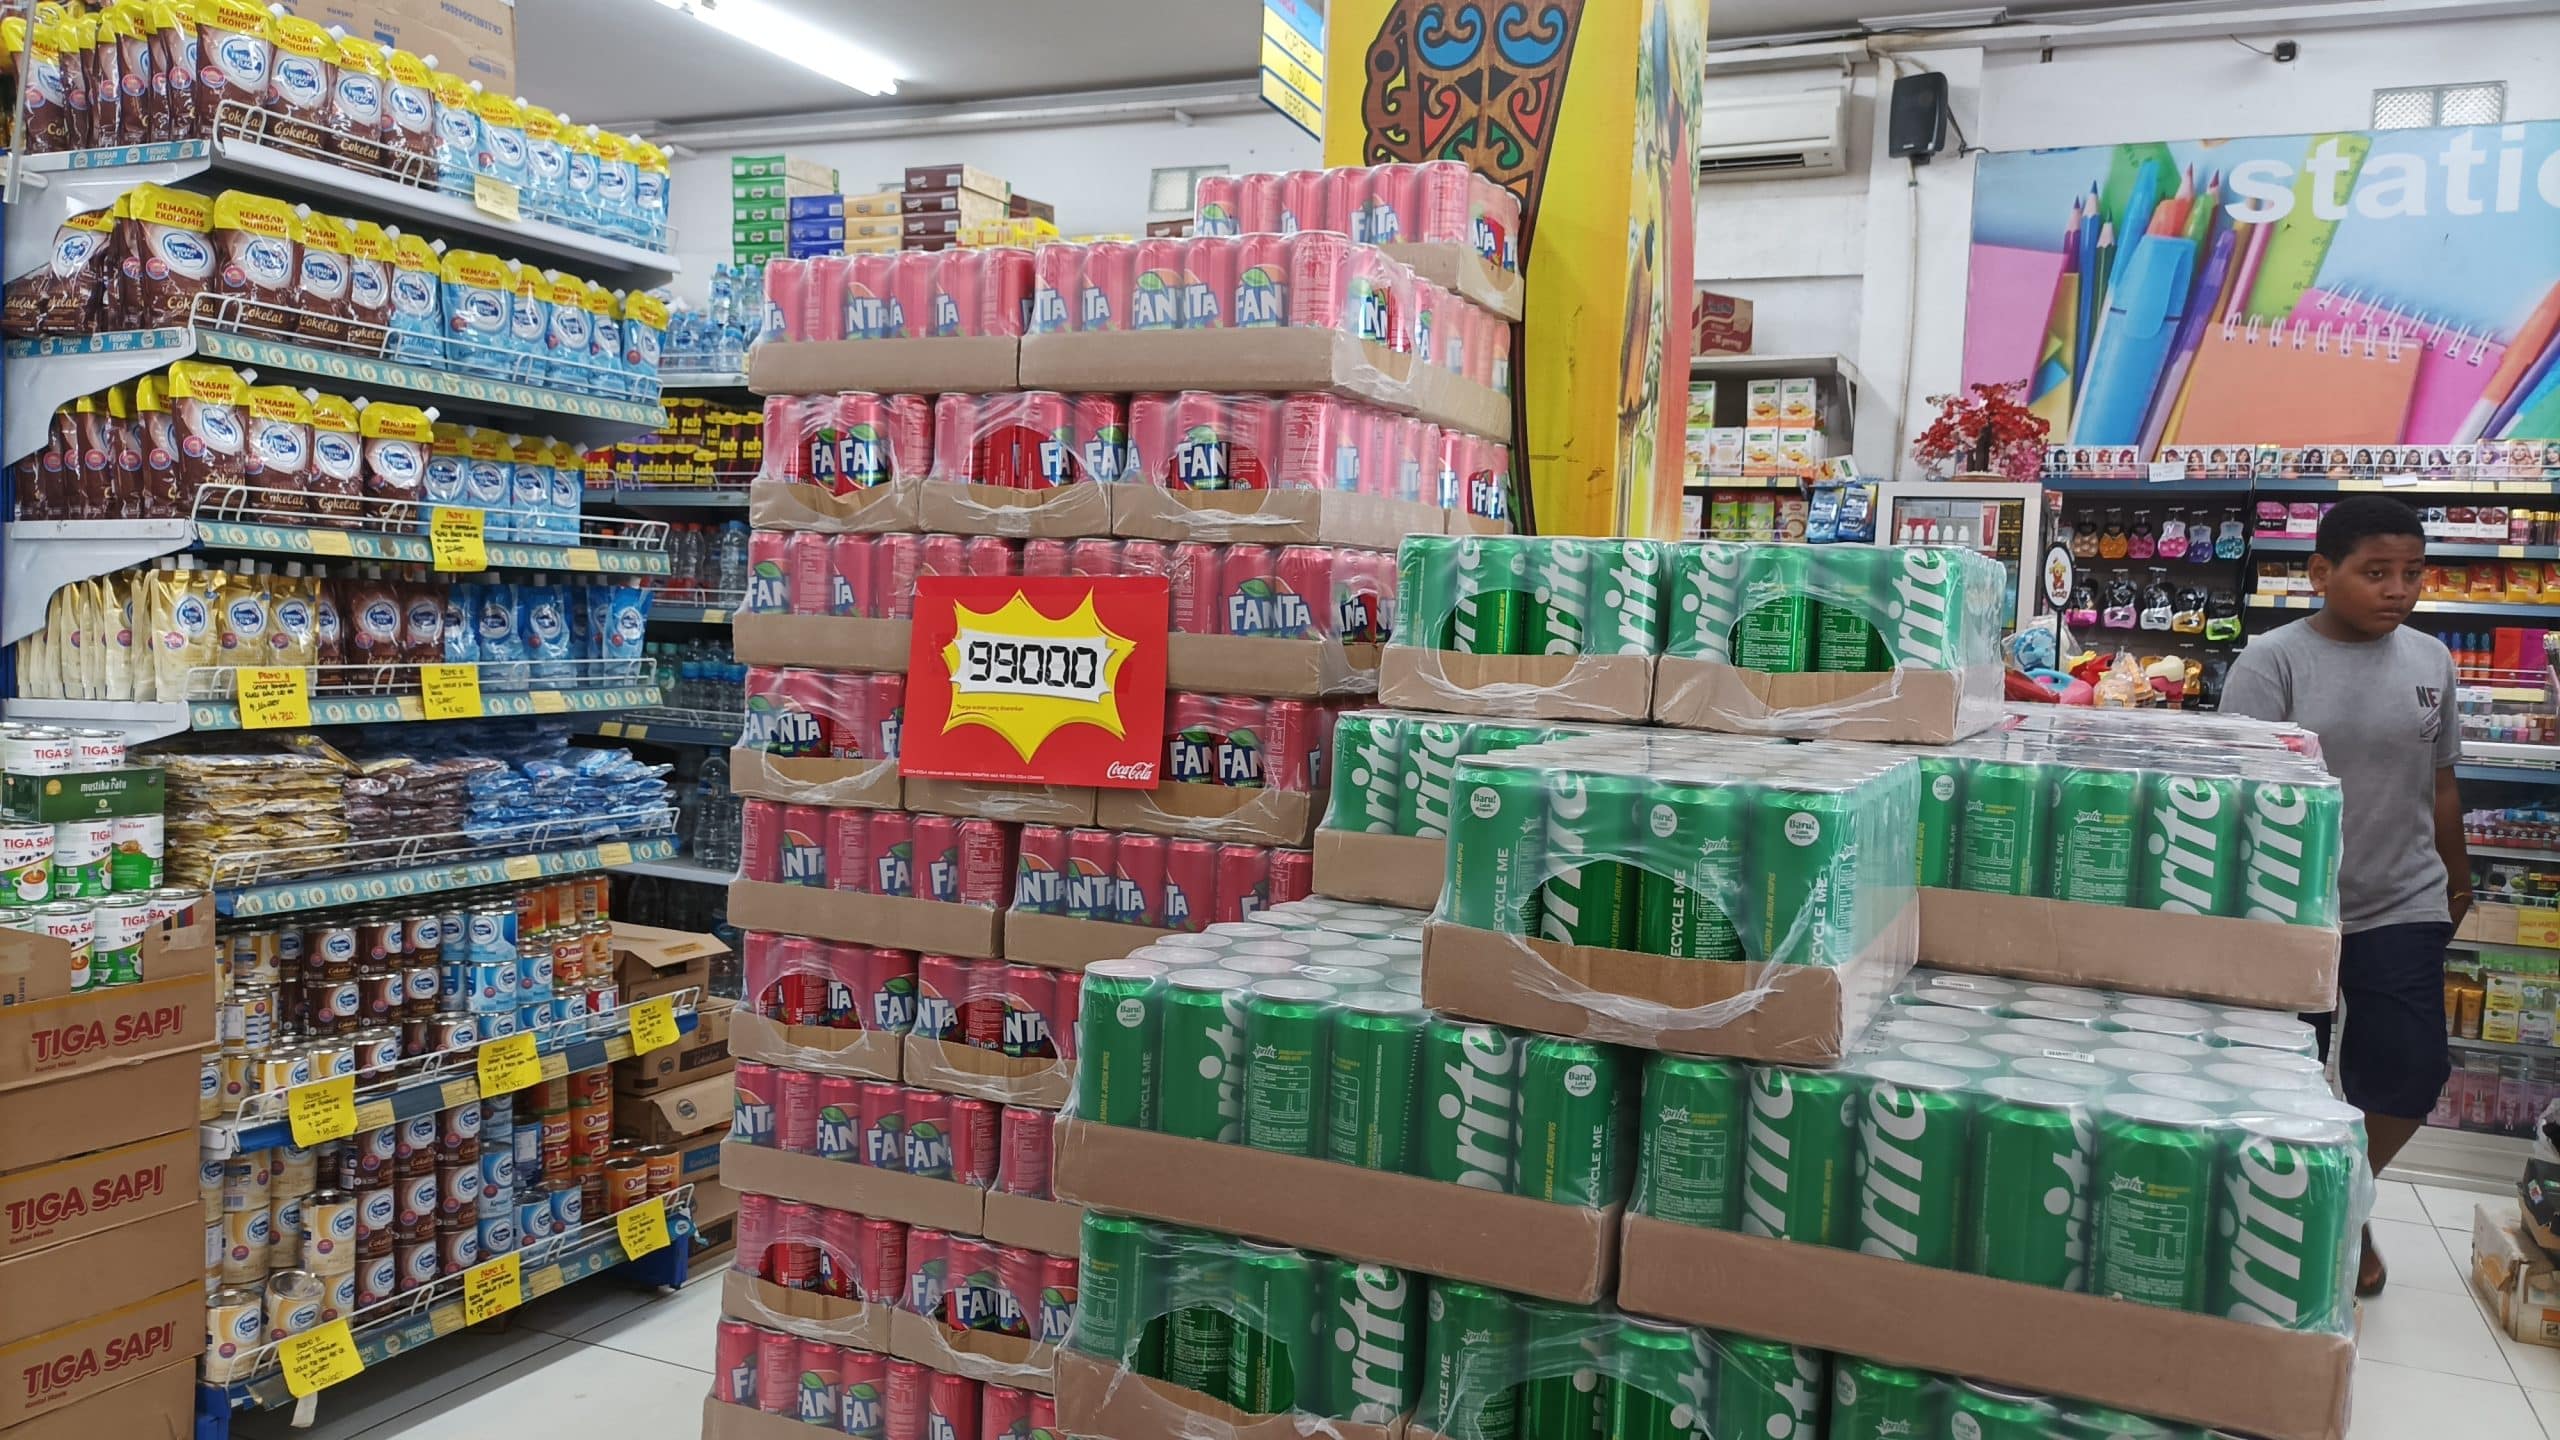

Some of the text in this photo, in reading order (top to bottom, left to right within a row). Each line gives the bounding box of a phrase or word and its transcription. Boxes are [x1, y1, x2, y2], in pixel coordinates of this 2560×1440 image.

[218, 7, 262, 24] KEMASAN
[156, 200, 204, 217] KEMASAN
[239, 210, 284, 224] KEMASAN
[155, 211, 205, 228] EKONOMIS
[255, 397, 295, 410] KEMASAN
[378, 427, 416, 438] EKONOMIS
[380, 419, 417, 431] KEMASAN
[1178, 441, 1227, 478] FAN
[318, 496, 361, 512] Cokelat
[833, 576, 854, 606] TA
[968, 641, 1097, 689] 99000
[780, 713, 821, 744] NTA
[34, 749, 62, 759] TIGA
[81, 746, 110, 756] TIGA
[1474, 793, 1497, 805] Baru!
[1788, 819, 1815, 831] Baru!
[3, 839, 34, 850] TIGA
[2057, 833, 2064, 853] ME
[1497, 847, 1509, 870] ME
[1674, 869, 1686, 893] ME
[1167, 885, 1188, 916] TA
[121, 916, 146, 928] TIGA
[48, 925, 79, 937] TIGA
[918, 997, 959, 1030] NTA
[1120, 1004, 1142, 1014] Baru!
[32, 1004, 183, 1063] TIGA SAPI
[1143, 1052, 1152, 1071] ME
[1568, 1071, 1593, 1083] Baru!
[1593, 1124, 1602, 1149] ME
[6, 1165, 163, 1233] TIGA SAPI
[23, 1321, 173, 1399] TIGA SAPI
[1441, 1354, 1451, 1383] ME
